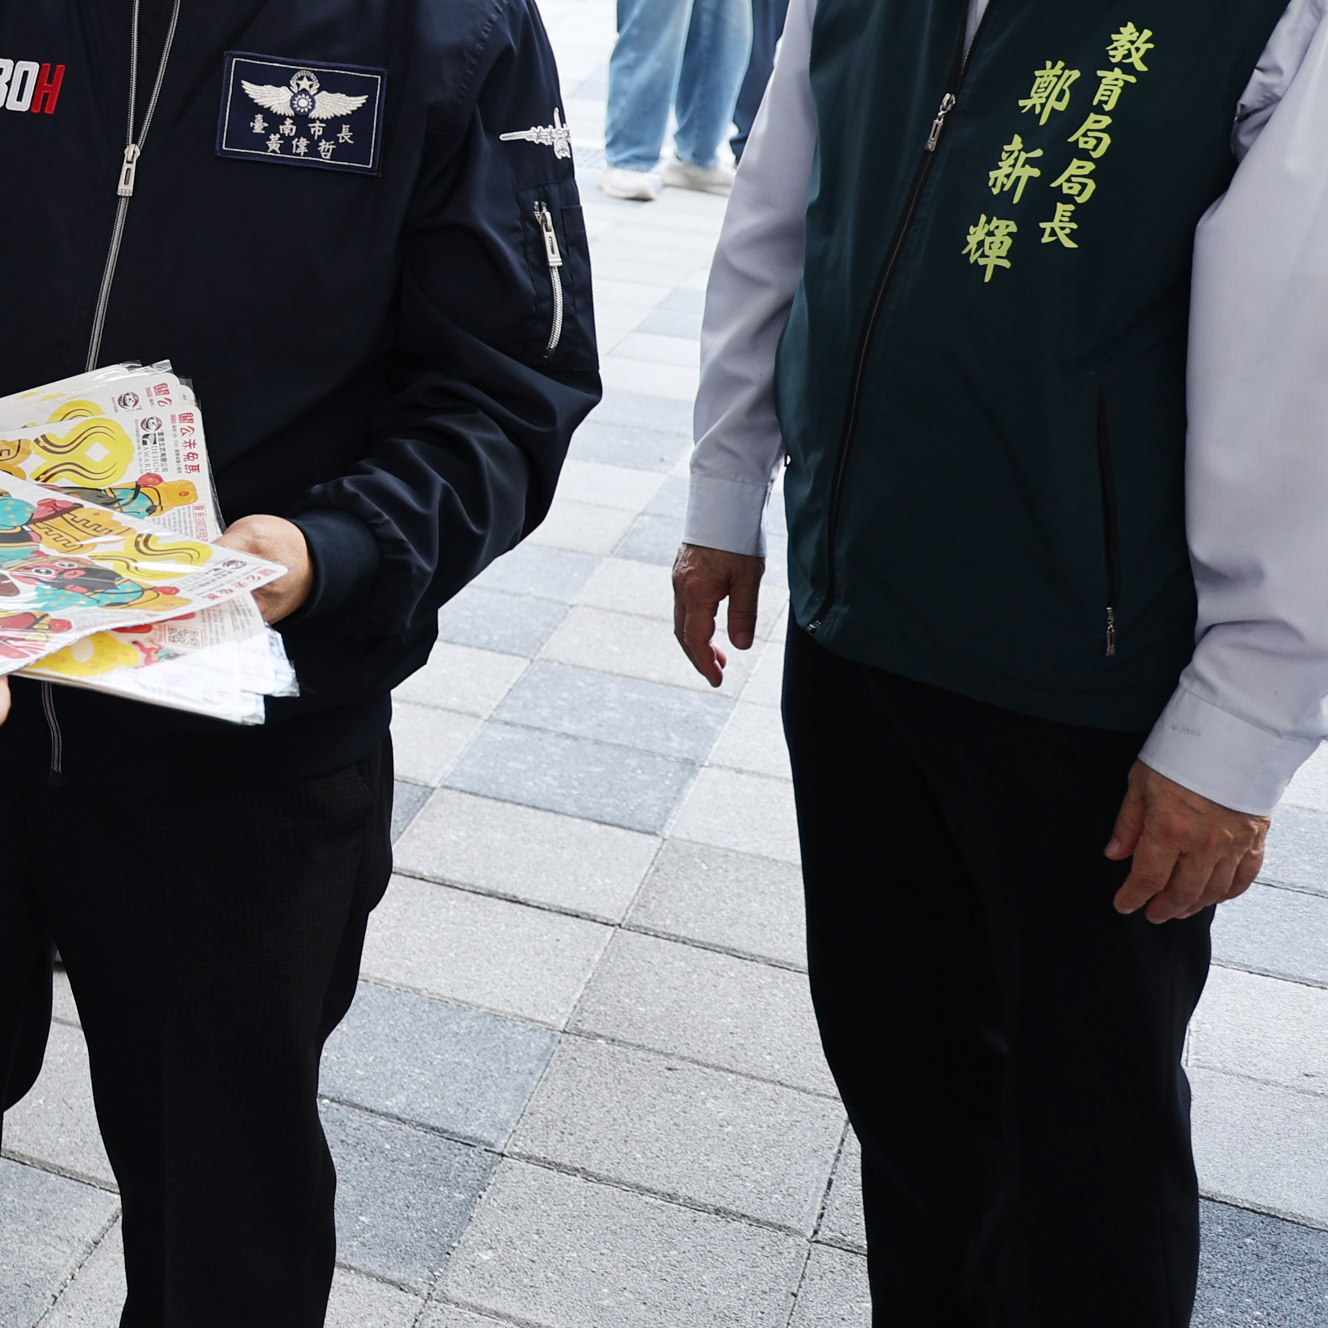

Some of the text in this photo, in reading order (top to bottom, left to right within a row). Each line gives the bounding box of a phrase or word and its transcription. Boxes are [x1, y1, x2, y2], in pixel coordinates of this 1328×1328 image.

[249, 113, 354, 144] 臺南市長
[1038, 22, 1155, 249] 教育局局長
[266, 133, 336, 159] 黃偉哲
[961, 60, 1081, 283] 鄭新輝
[151, 445, 160, 473] DESIGN
